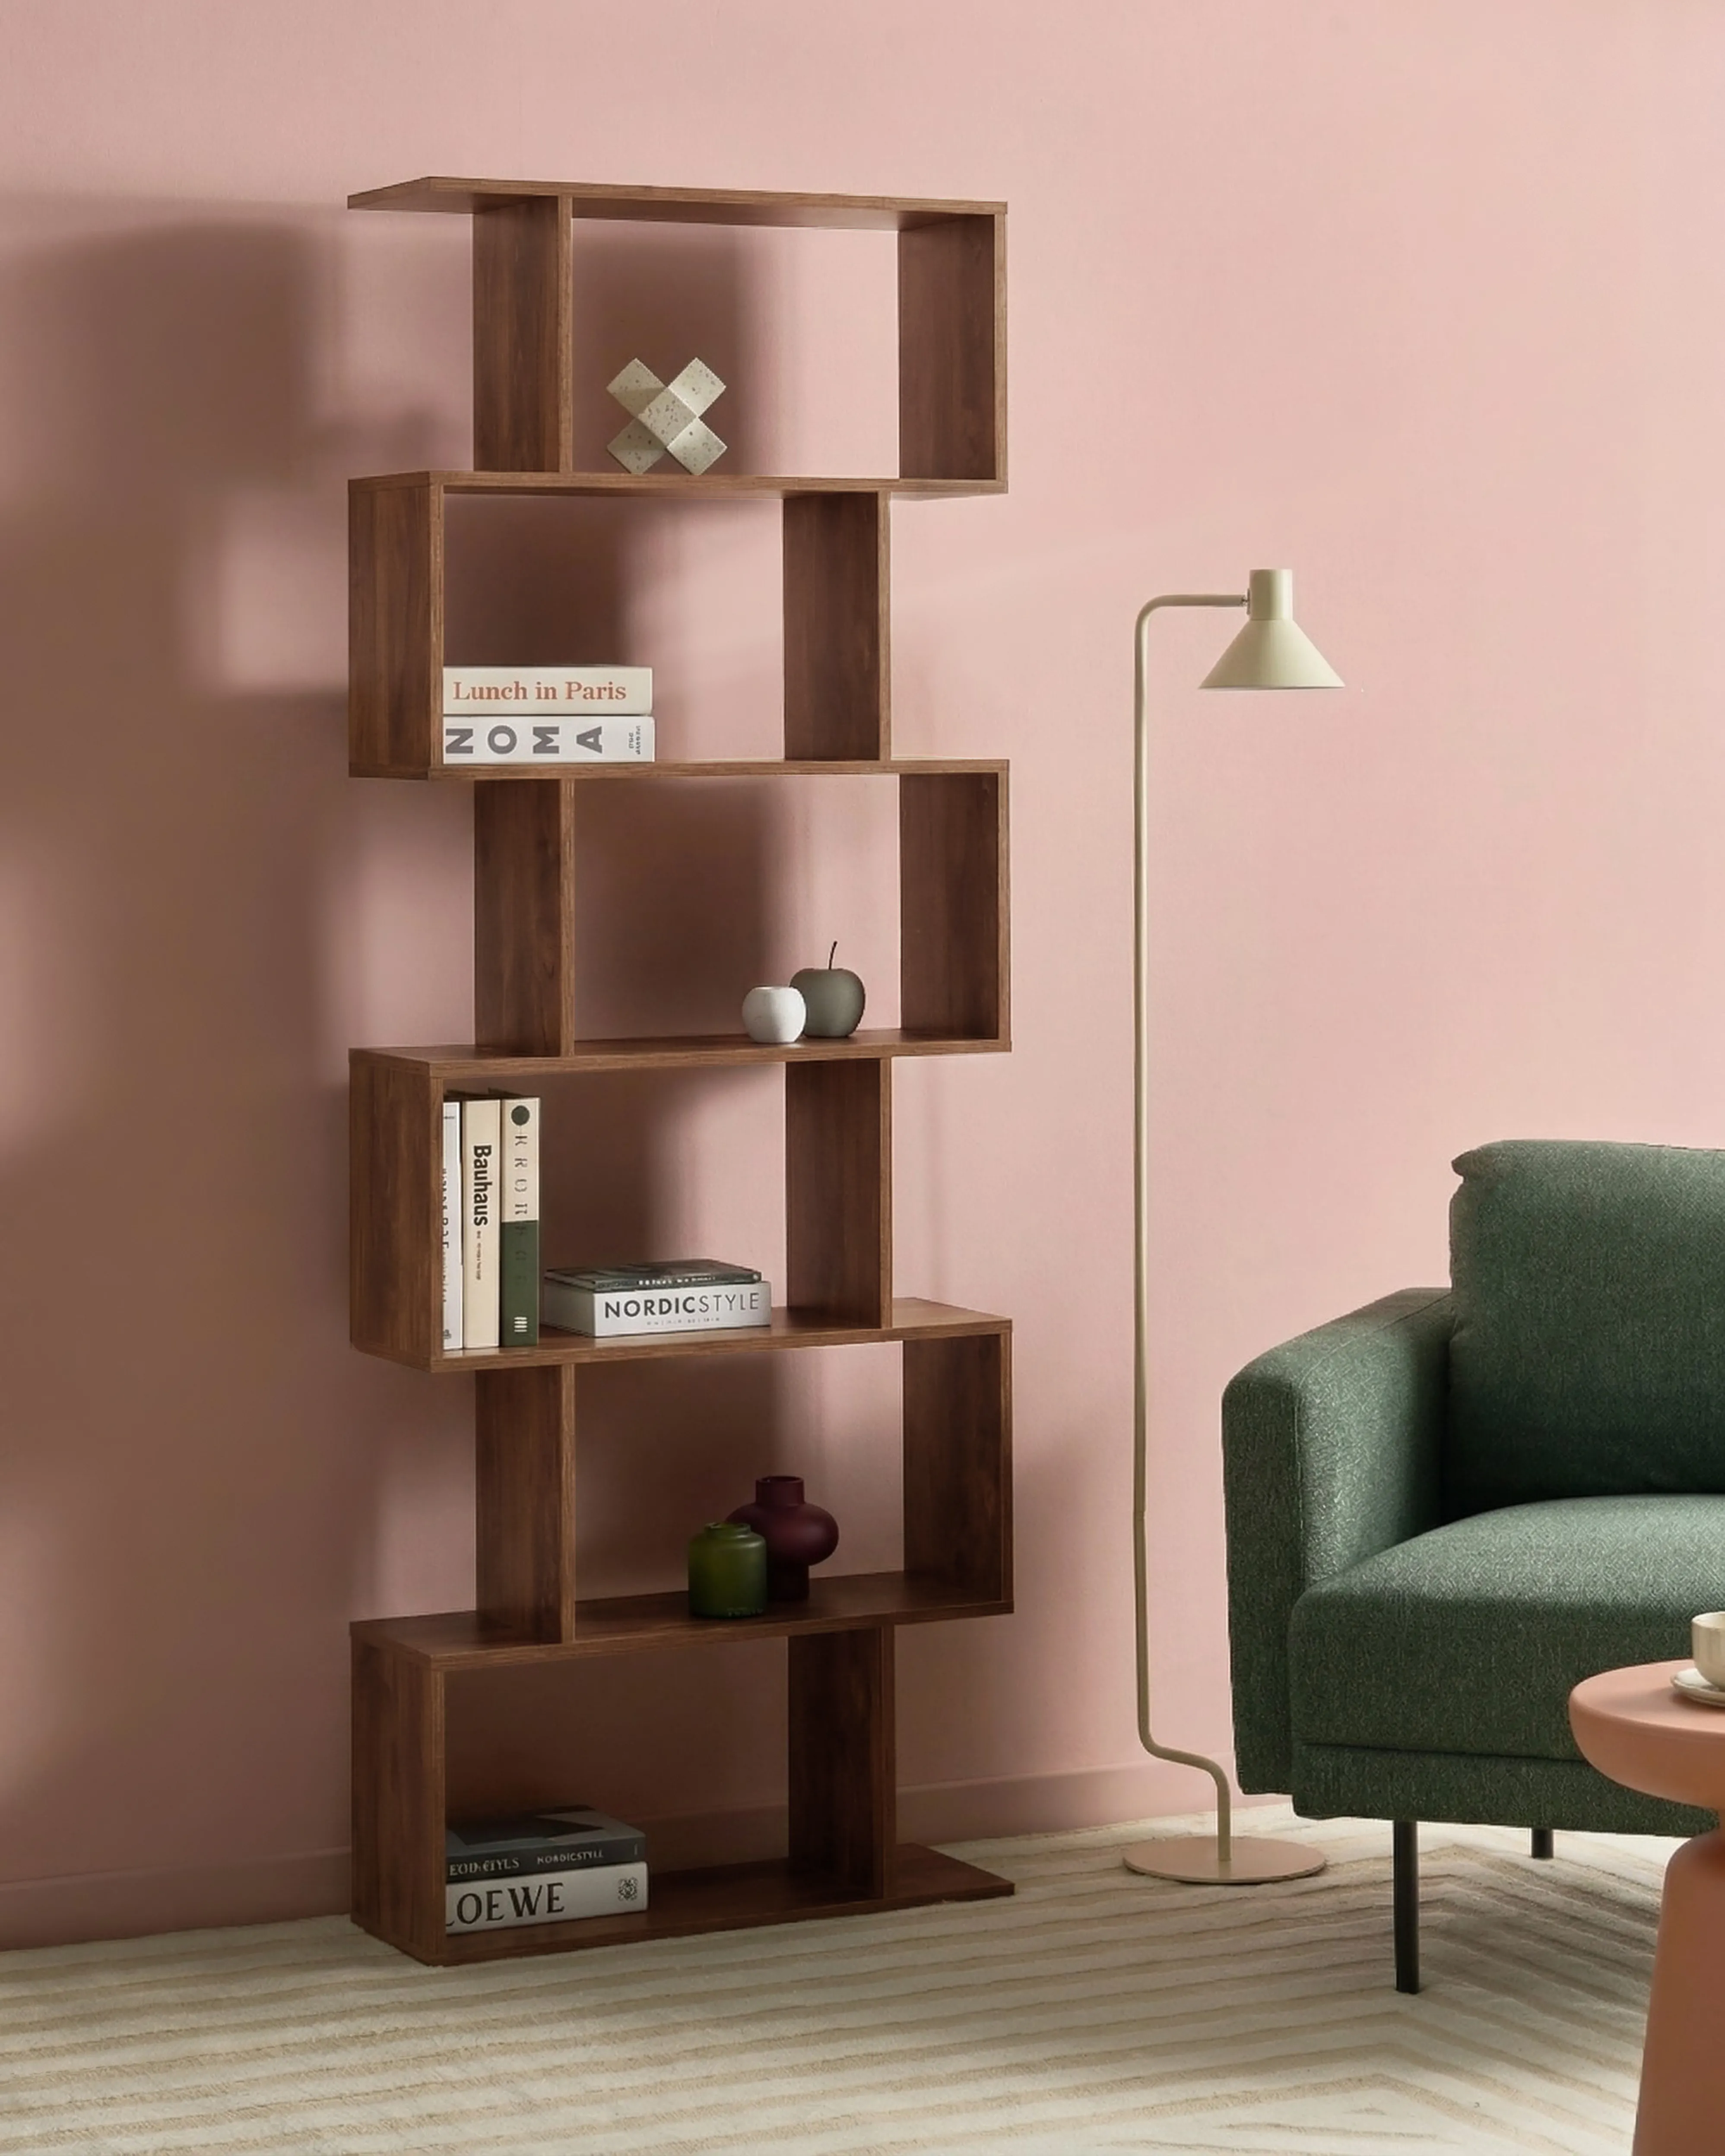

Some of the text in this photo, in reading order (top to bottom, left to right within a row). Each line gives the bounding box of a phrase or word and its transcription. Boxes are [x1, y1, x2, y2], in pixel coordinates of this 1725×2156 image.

[453, 681, 627, 700] Lunch in Paris
[445, 725, 602, 755] NOMA
[473, 1145, 492, 1226] Bauhaus
[605, 1292, 760, 1319] NORDICSTYLE
[446, 1882, 564, 1927] OEWE
